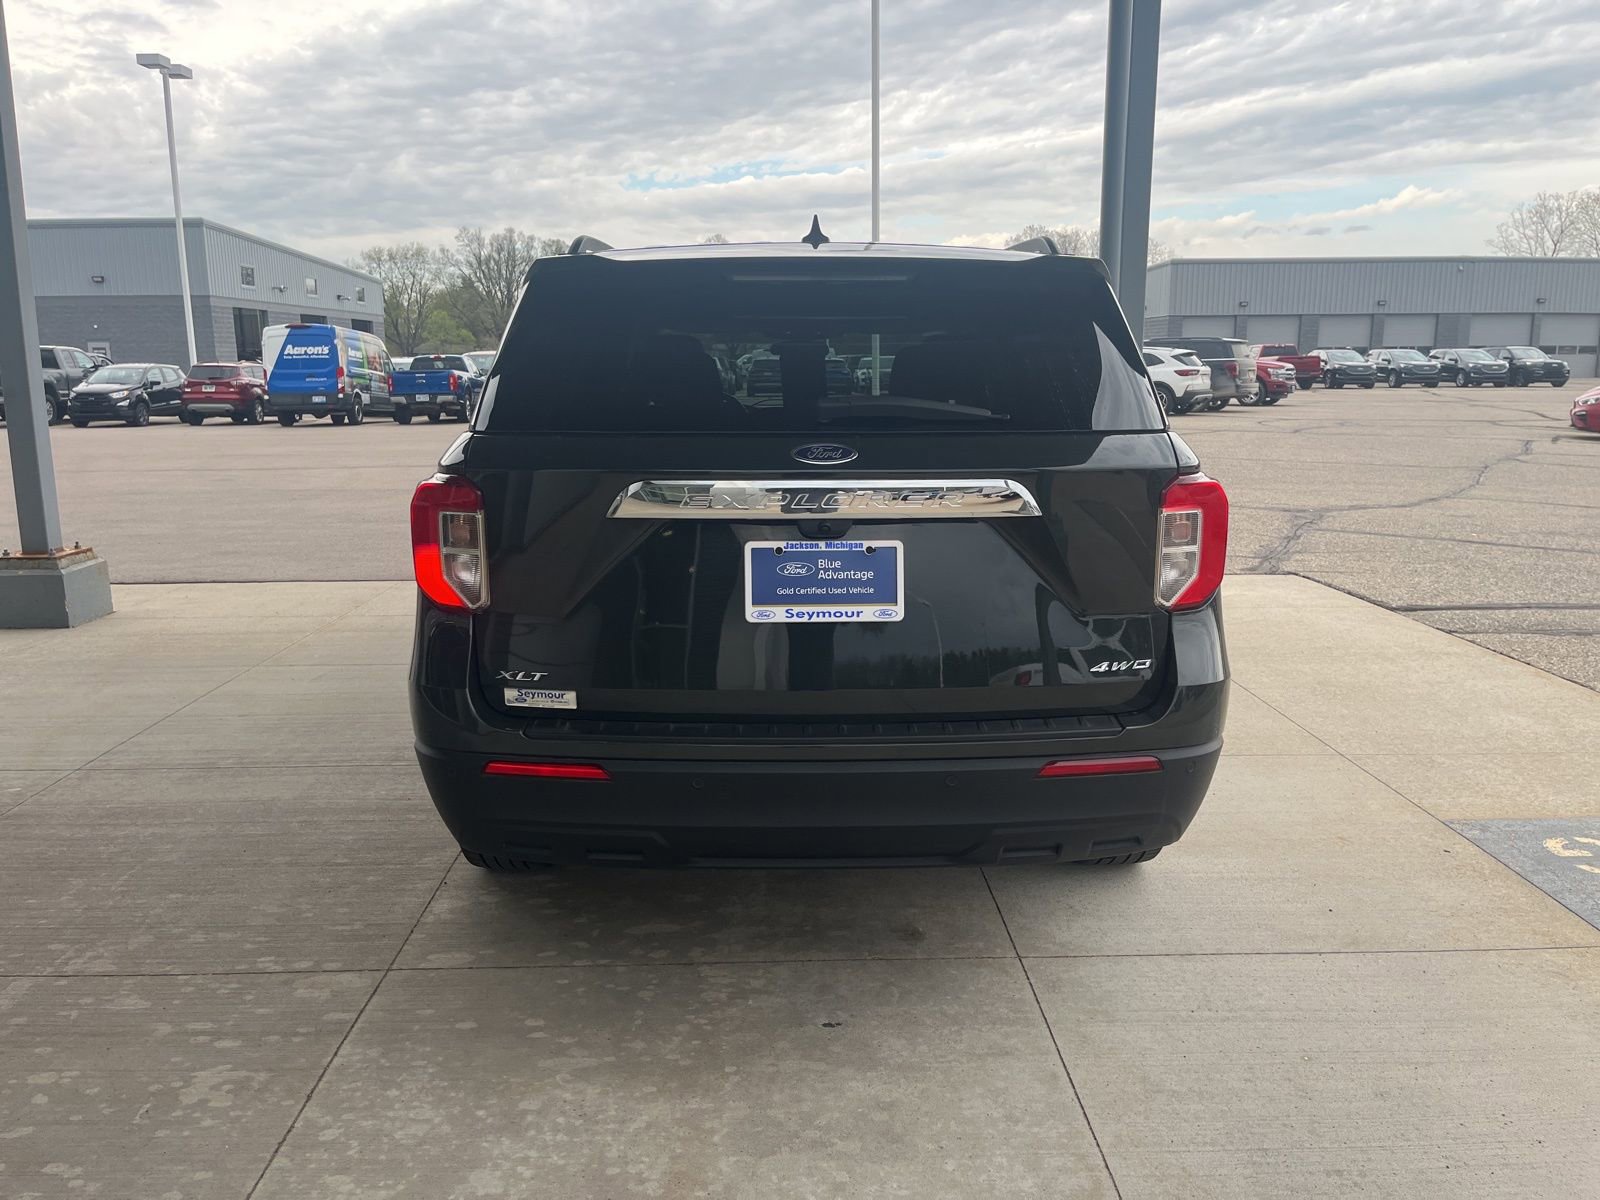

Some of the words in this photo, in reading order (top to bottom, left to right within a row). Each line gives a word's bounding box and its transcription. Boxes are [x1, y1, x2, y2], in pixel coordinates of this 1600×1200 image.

[807, 446, 843, 459] Ford
[679, 491, 963, 510] EXPLORER
[824, 541, 864, 550] Michigan
[783, 563, 808, 575] Ford
[818, 559, 842, 569] Blue
[817, 570, 874, 581] Advantage
[776, 587, 794, 595] Gold
[795, 587, 827, 595] Certified
[828, 586, 847, 595] Used
[848, 586, 875, 594] Vehicle
[785, 608, 864, 621] Seymour
[1089, 658, 1152, 673] 4WD
[495, 670, 549, 681] XLT
[517, 688, 566, 699] Seymour
